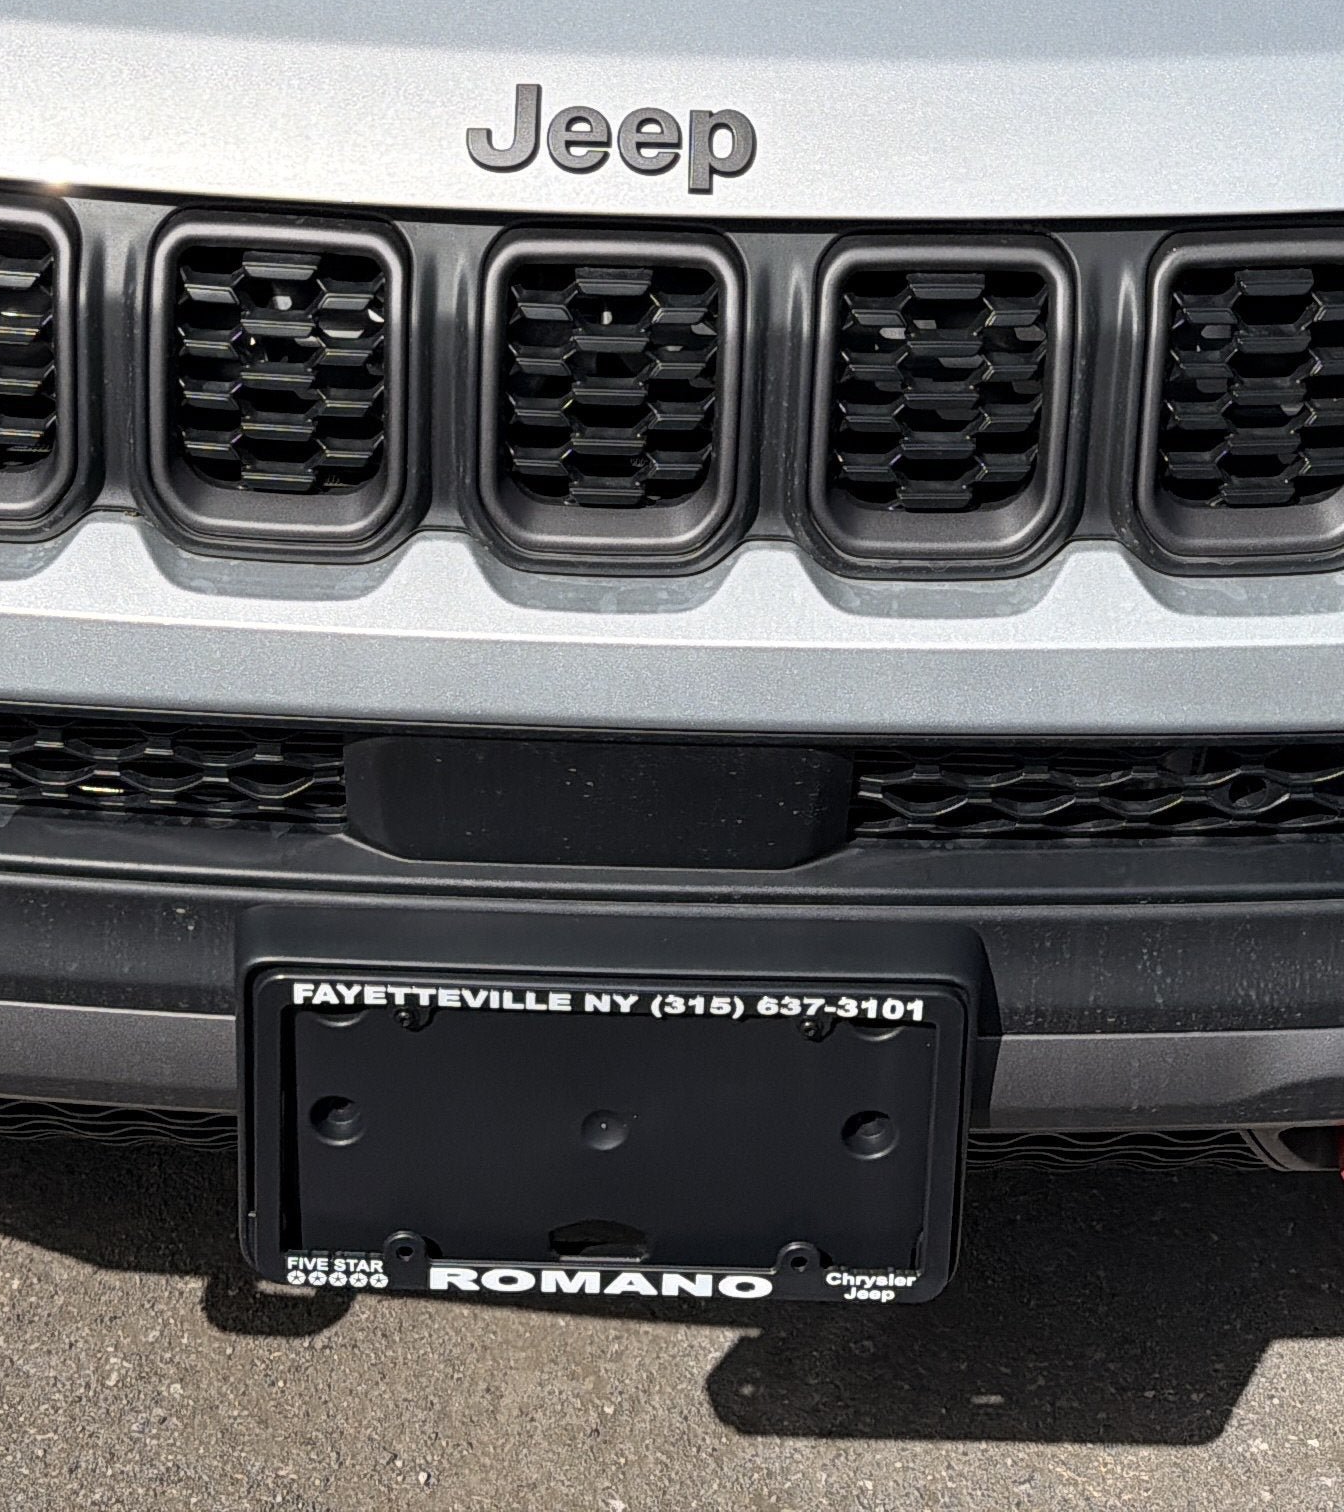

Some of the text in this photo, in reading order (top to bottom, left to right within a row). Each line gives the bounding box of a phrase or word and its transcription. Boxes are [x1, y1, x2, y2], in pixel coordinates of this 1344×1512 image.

[466, 83, 757, 195] Jeep
[293, 983, 924, 1021] FAYETTEVILLE NY (315) 637-3101
[287, 1256, 384, 1273] FIVE STAR
[429, 1267, 773, 1299] ROMANO
[826, 1272, 917, 1288] Chrysler
[843, 1287, 896, 1303] Jeep
